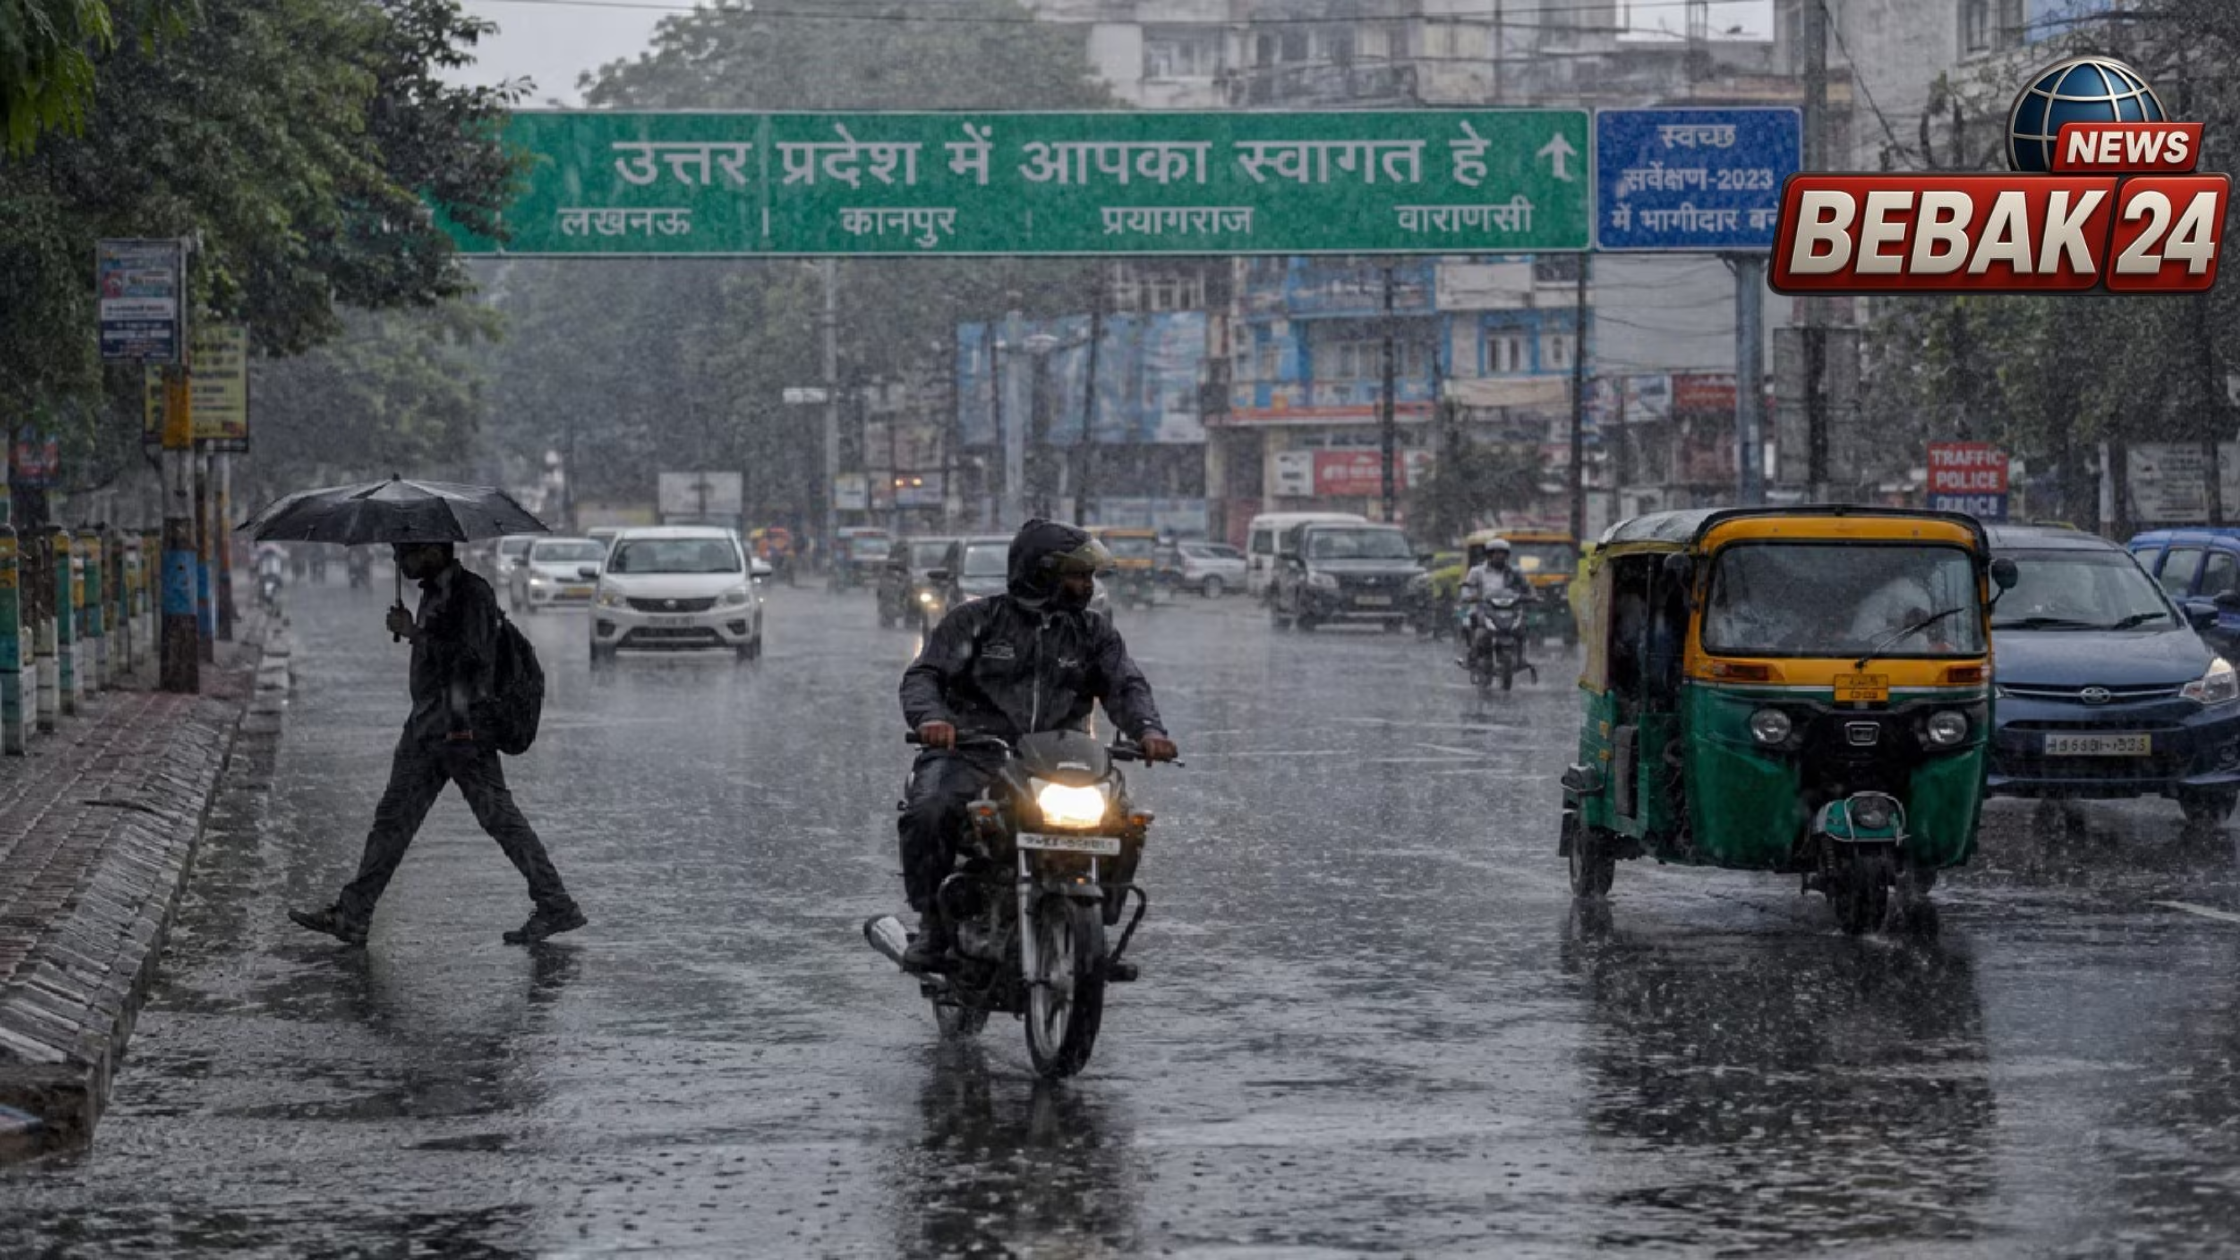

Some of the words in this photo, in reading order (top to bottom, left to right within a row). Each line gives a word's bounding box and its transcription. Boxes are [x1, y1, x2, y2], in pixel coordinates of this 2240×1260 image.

[1657, 124, 1737, 149] स्वच्छ
[612, 141, 752, 185] उत्तर
[776, 123, 922, 188] प्रदेश
[945, 123, 992, 185] में
[1018, 141, 1212, 185] आपका
[1235, 140, 1426, 183] स्वागत
[558, 208, 691, 235] लखनऊ
[1101, 206, 1254, 234] प्रयागराज
[1393, 195, 1534, 232] वाराणसी
[1611, 202, 1631, 231] में
[1640, 202, 1738, 232] भागीदार
[839, 208, 957, 248] कानपुर
[1931, 449, 2004, 467] TRAFFIC
[1936, 471, 1999, 489] POLICE
